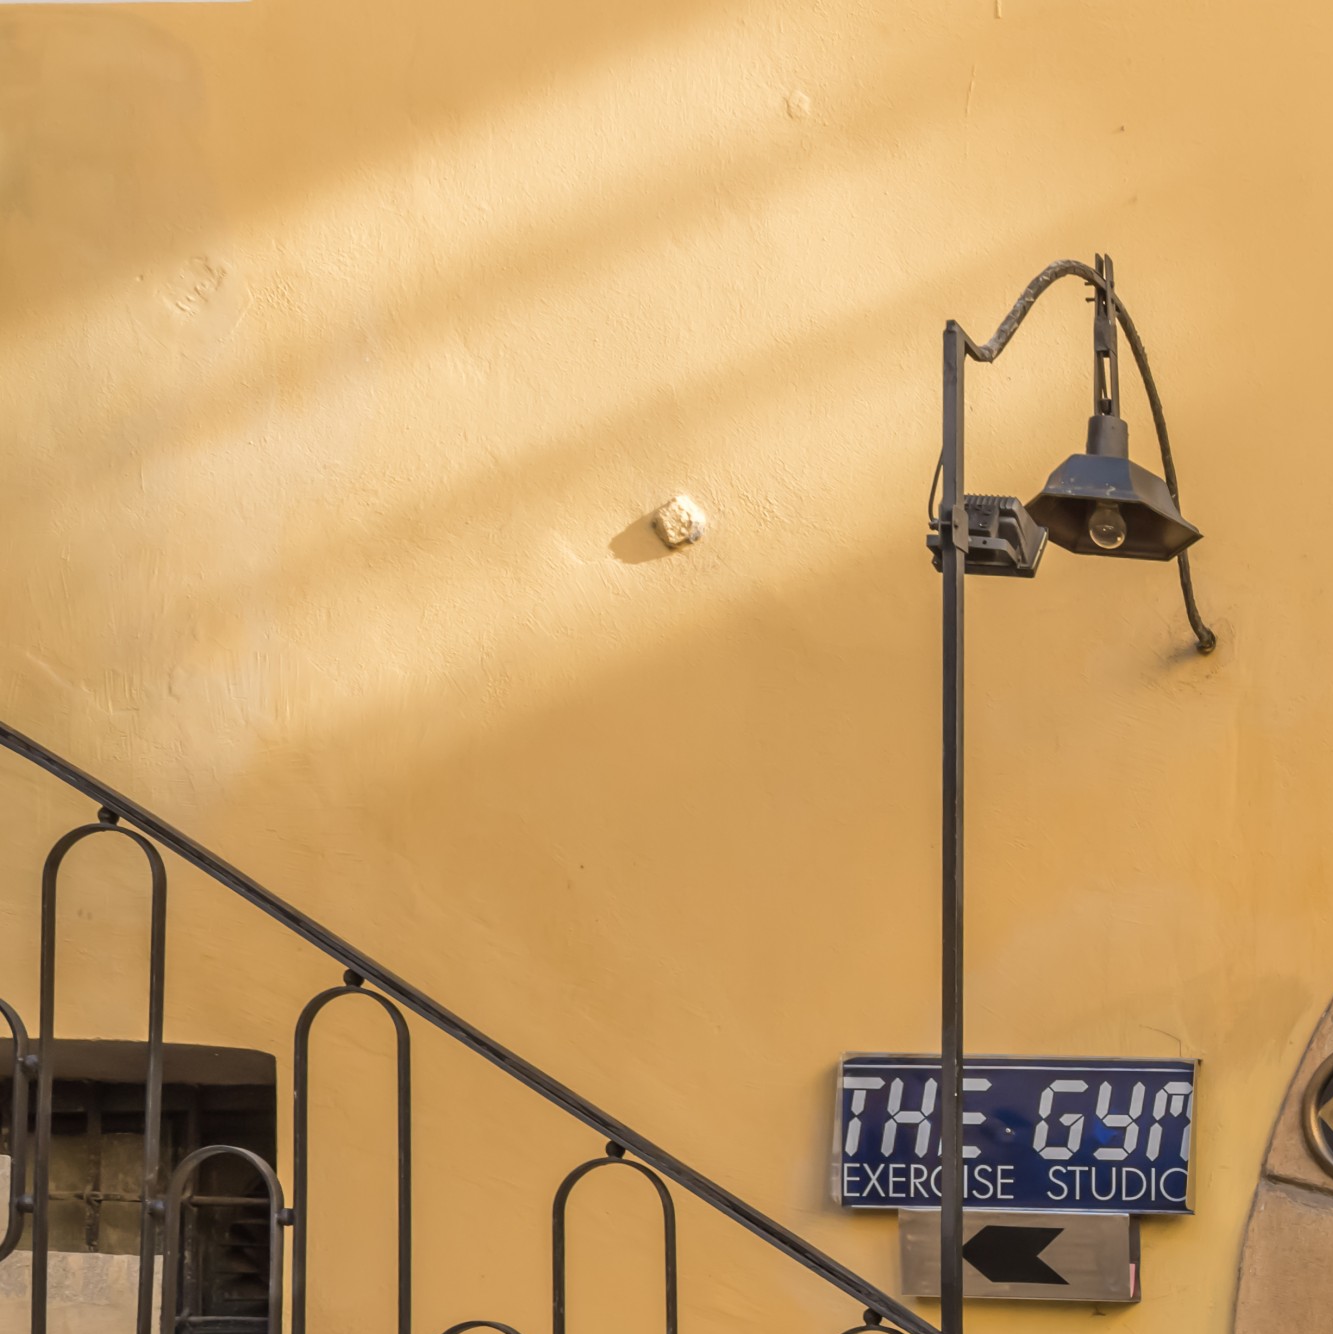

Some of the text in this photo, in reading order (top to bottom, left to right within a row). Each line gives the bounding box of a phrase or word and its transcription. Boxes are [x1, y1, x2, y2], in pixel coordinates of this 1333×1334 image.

[844, 1077, 1193, 1162] THE GYM
[1047, 1166, 1188, 1202] STUDIO
